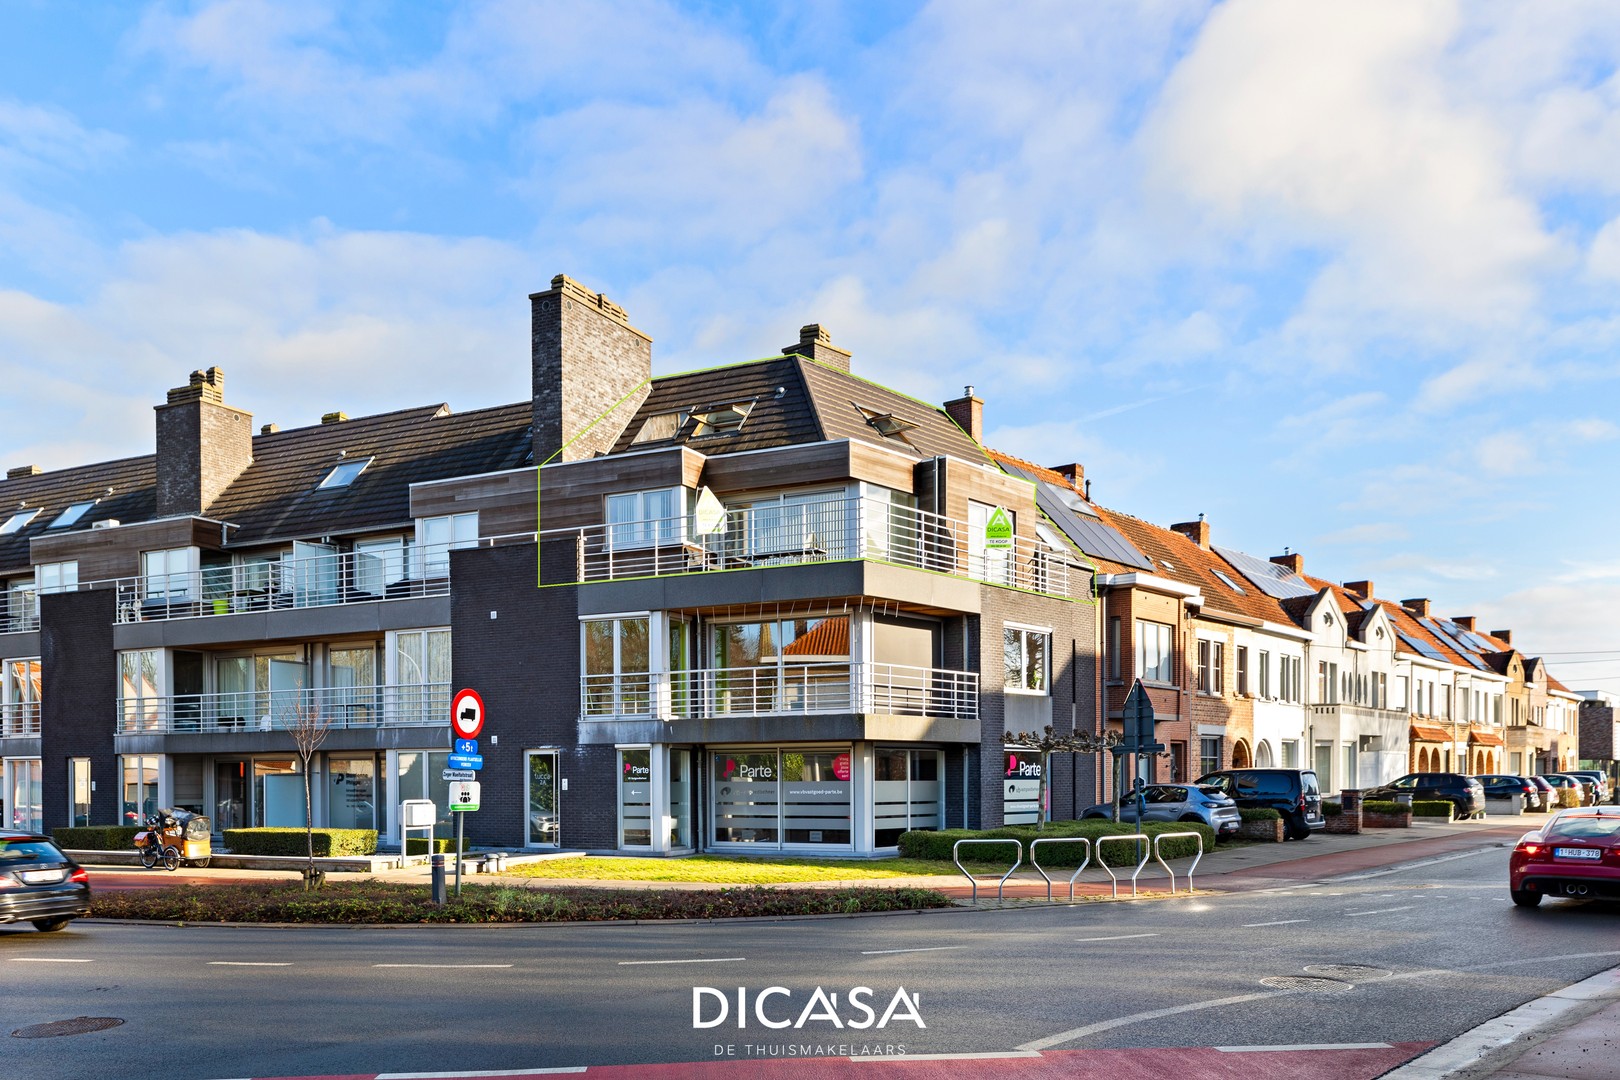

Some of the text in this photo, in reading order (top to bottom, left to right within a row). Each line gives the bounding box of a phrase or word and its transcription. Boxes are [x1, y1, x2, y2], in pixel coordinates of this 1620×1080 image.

[632, 766, 649, 774] Parte
[740, 764, 772, 778] Parte
[1019, 761, 1041, 776] Parte
